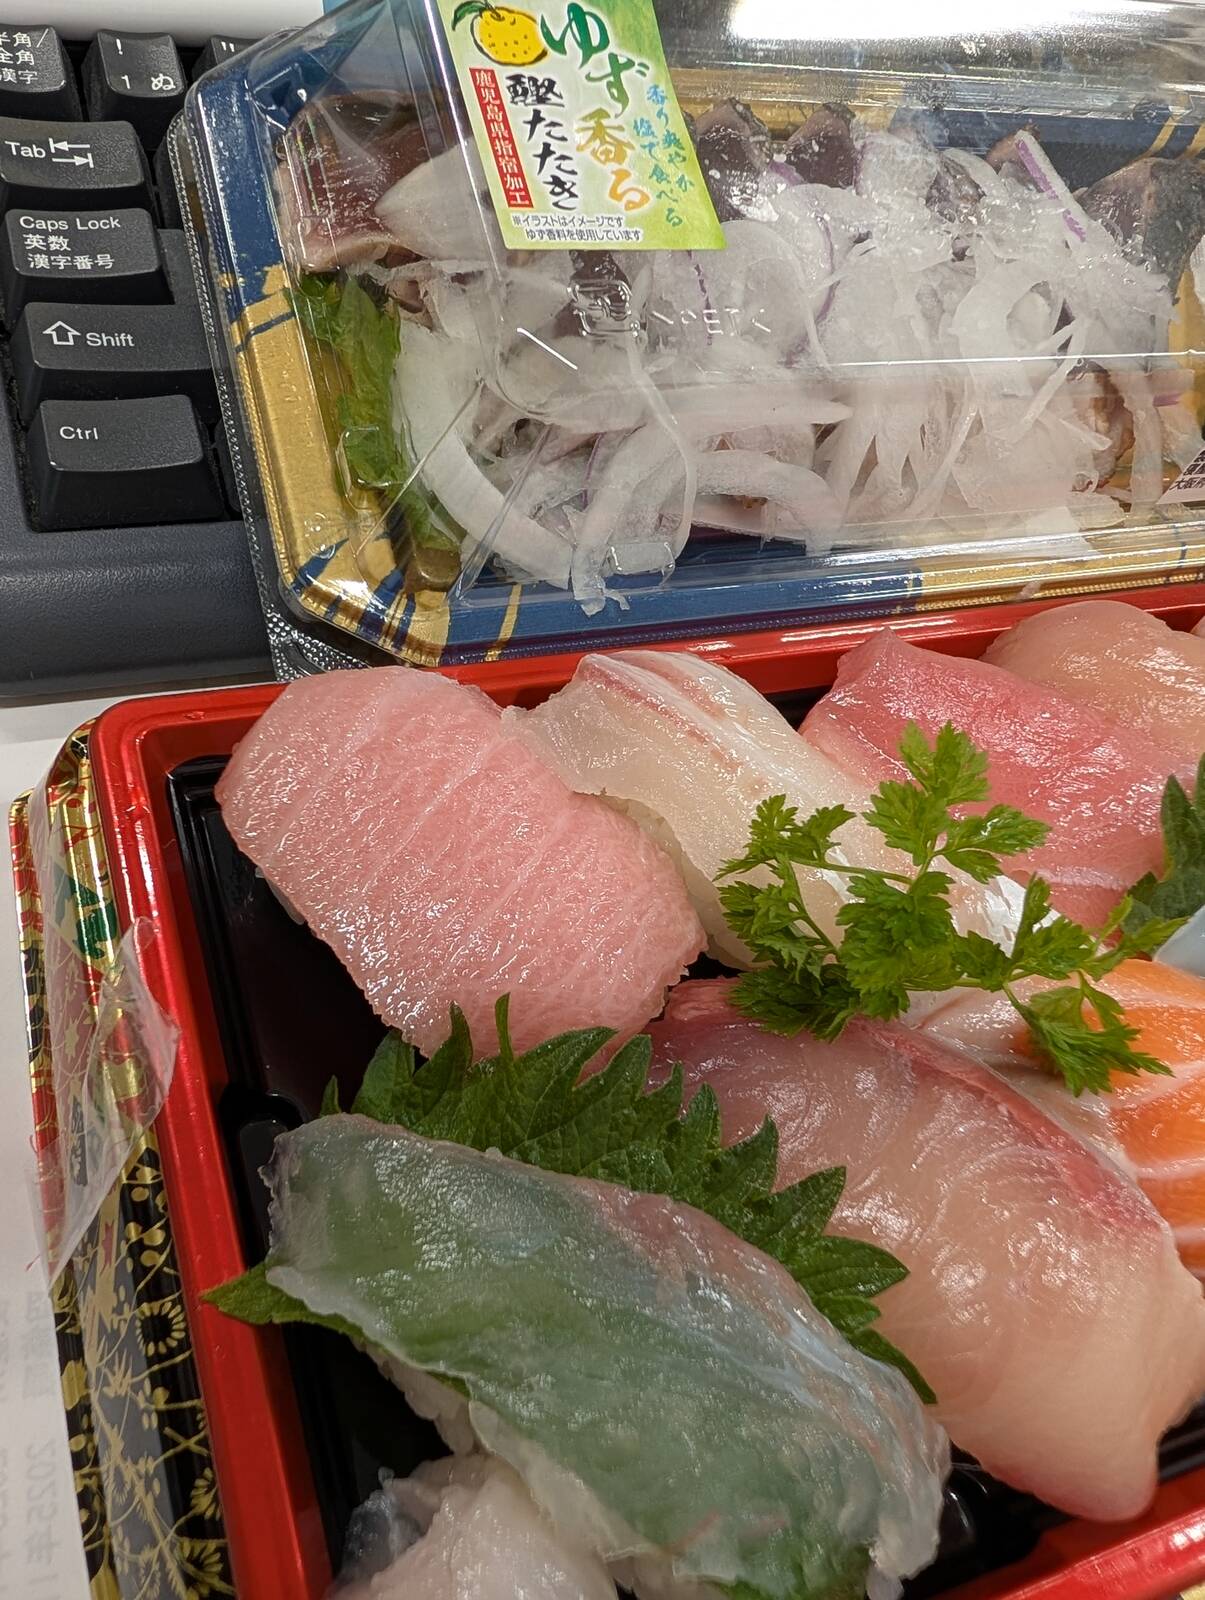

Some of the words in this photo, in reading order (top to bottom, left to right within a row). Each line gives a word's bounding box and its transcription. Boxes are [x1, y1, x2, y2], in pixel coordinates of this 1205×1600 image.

[150, 73, 176, 91] ぬ
[540, 2, 652, 212] ゆず香る
[474, 69, 531, 206] 鹿児島県指宿加工
[504, 73, 579, 211] 鰹たたき
[4, 140, 46, 159] Tab
[19, 216, 69, 232] Caps
[76, 216, 121, 230] Lock
[23, 233, 71, 251] 英数
[525, 228, 642, 241] ゆず香料を使用しています
[27, 253, 115, 270] 漢字番号
[85, 332, 135, 347] Shift
[59, 426, 99, 440] Ctrl
